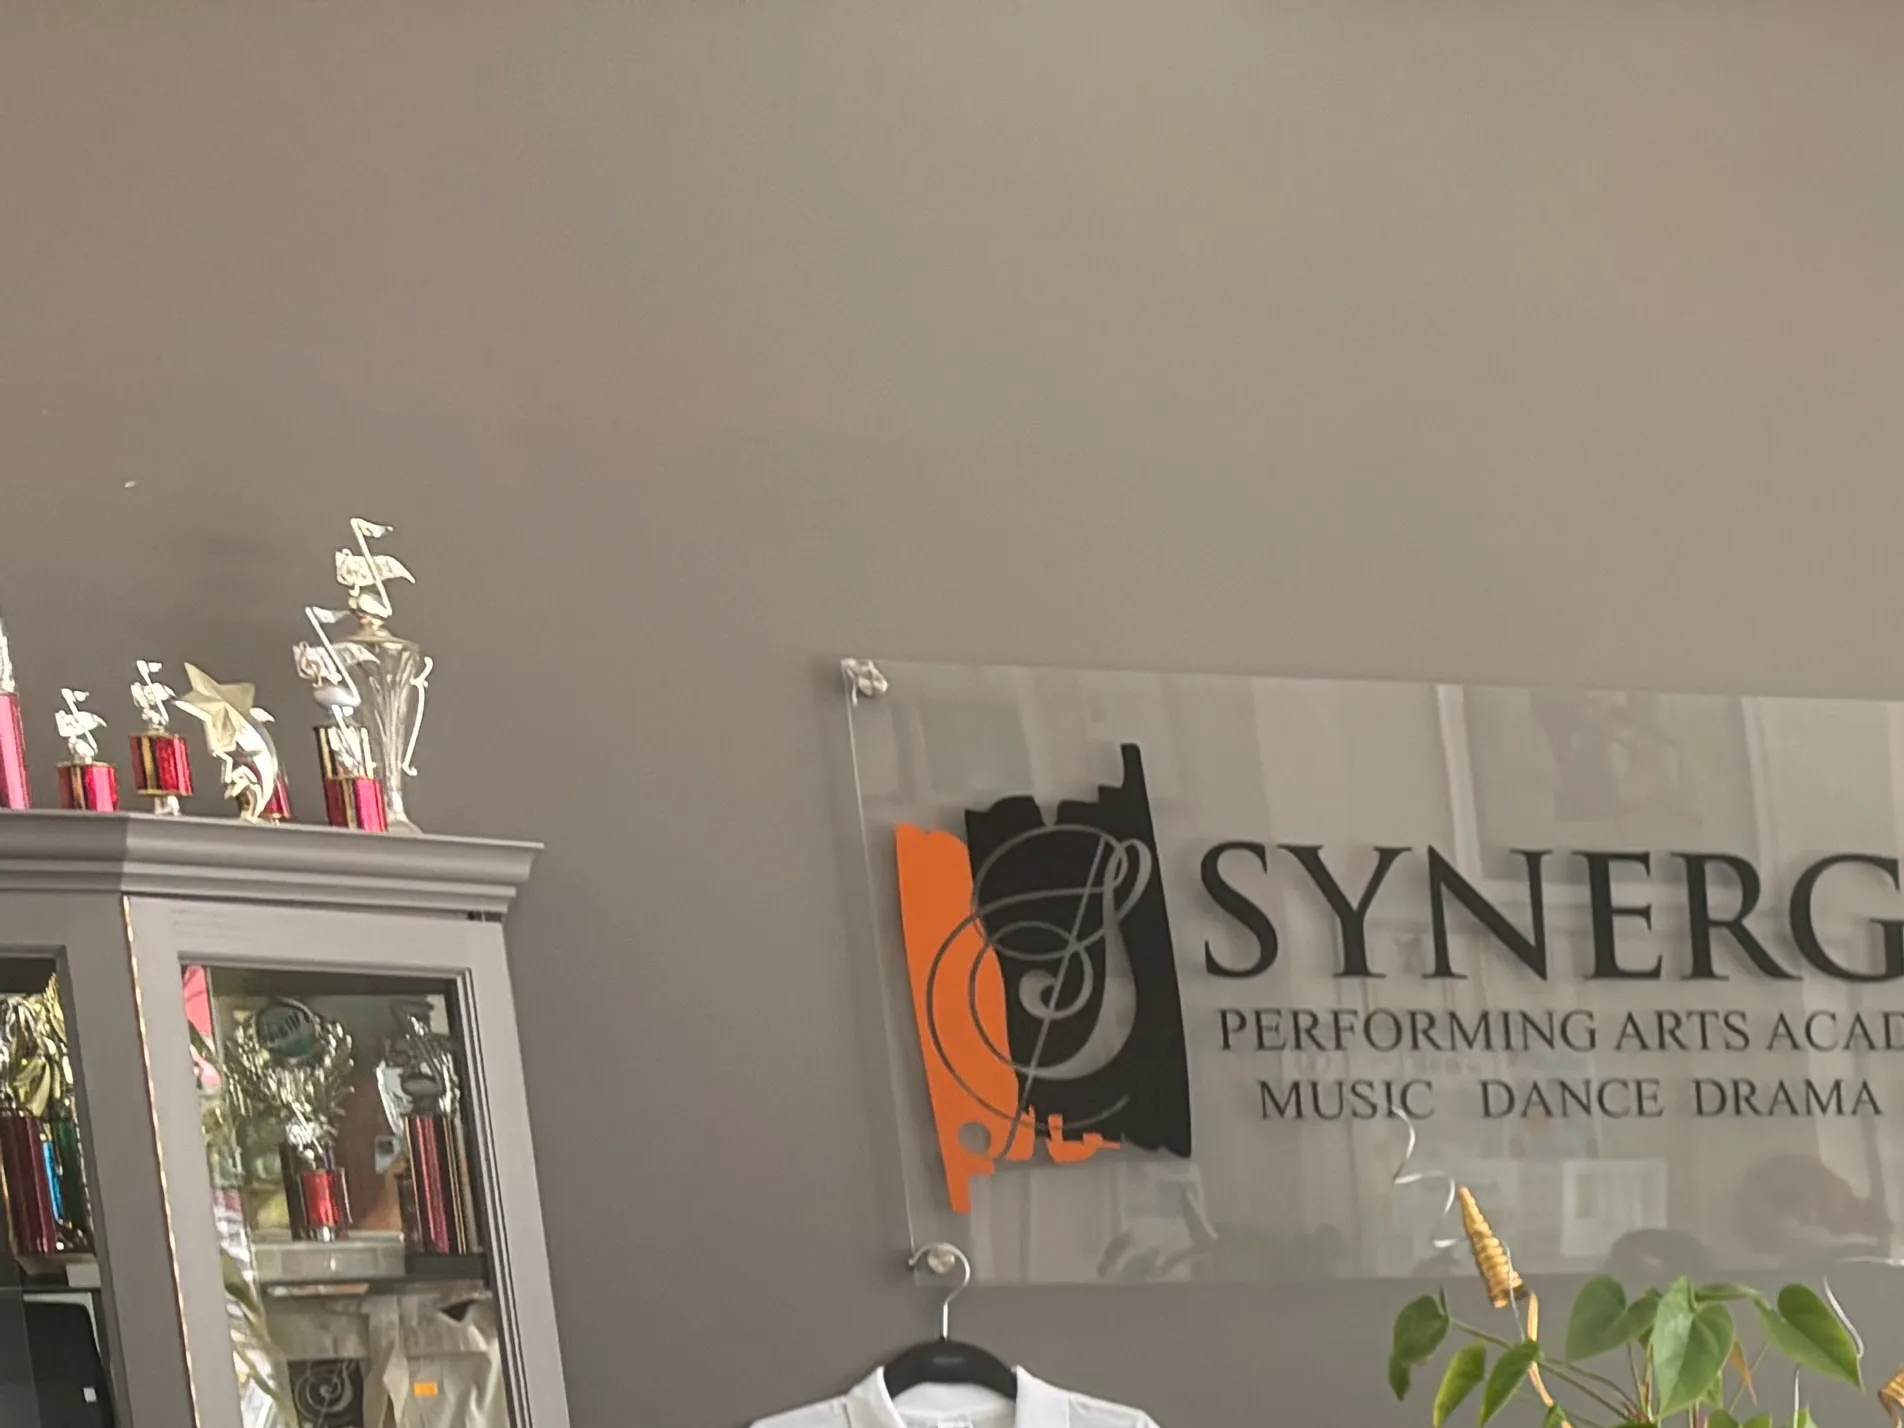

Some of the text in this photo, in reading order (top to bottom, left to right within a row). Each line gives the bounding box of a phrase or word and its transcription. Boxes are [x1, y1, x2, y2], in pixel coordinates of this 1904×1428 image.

[1217, 1008, 1600, 1052] PERFORMING
[1614, 1009, 1750, 1052] ARTS
[1259, 1078, 1435, 1121] MUSIC
[1480, 1079, 1664, 1120] DANCE
[1692, 1079, 1883, 1119] DRAMA
